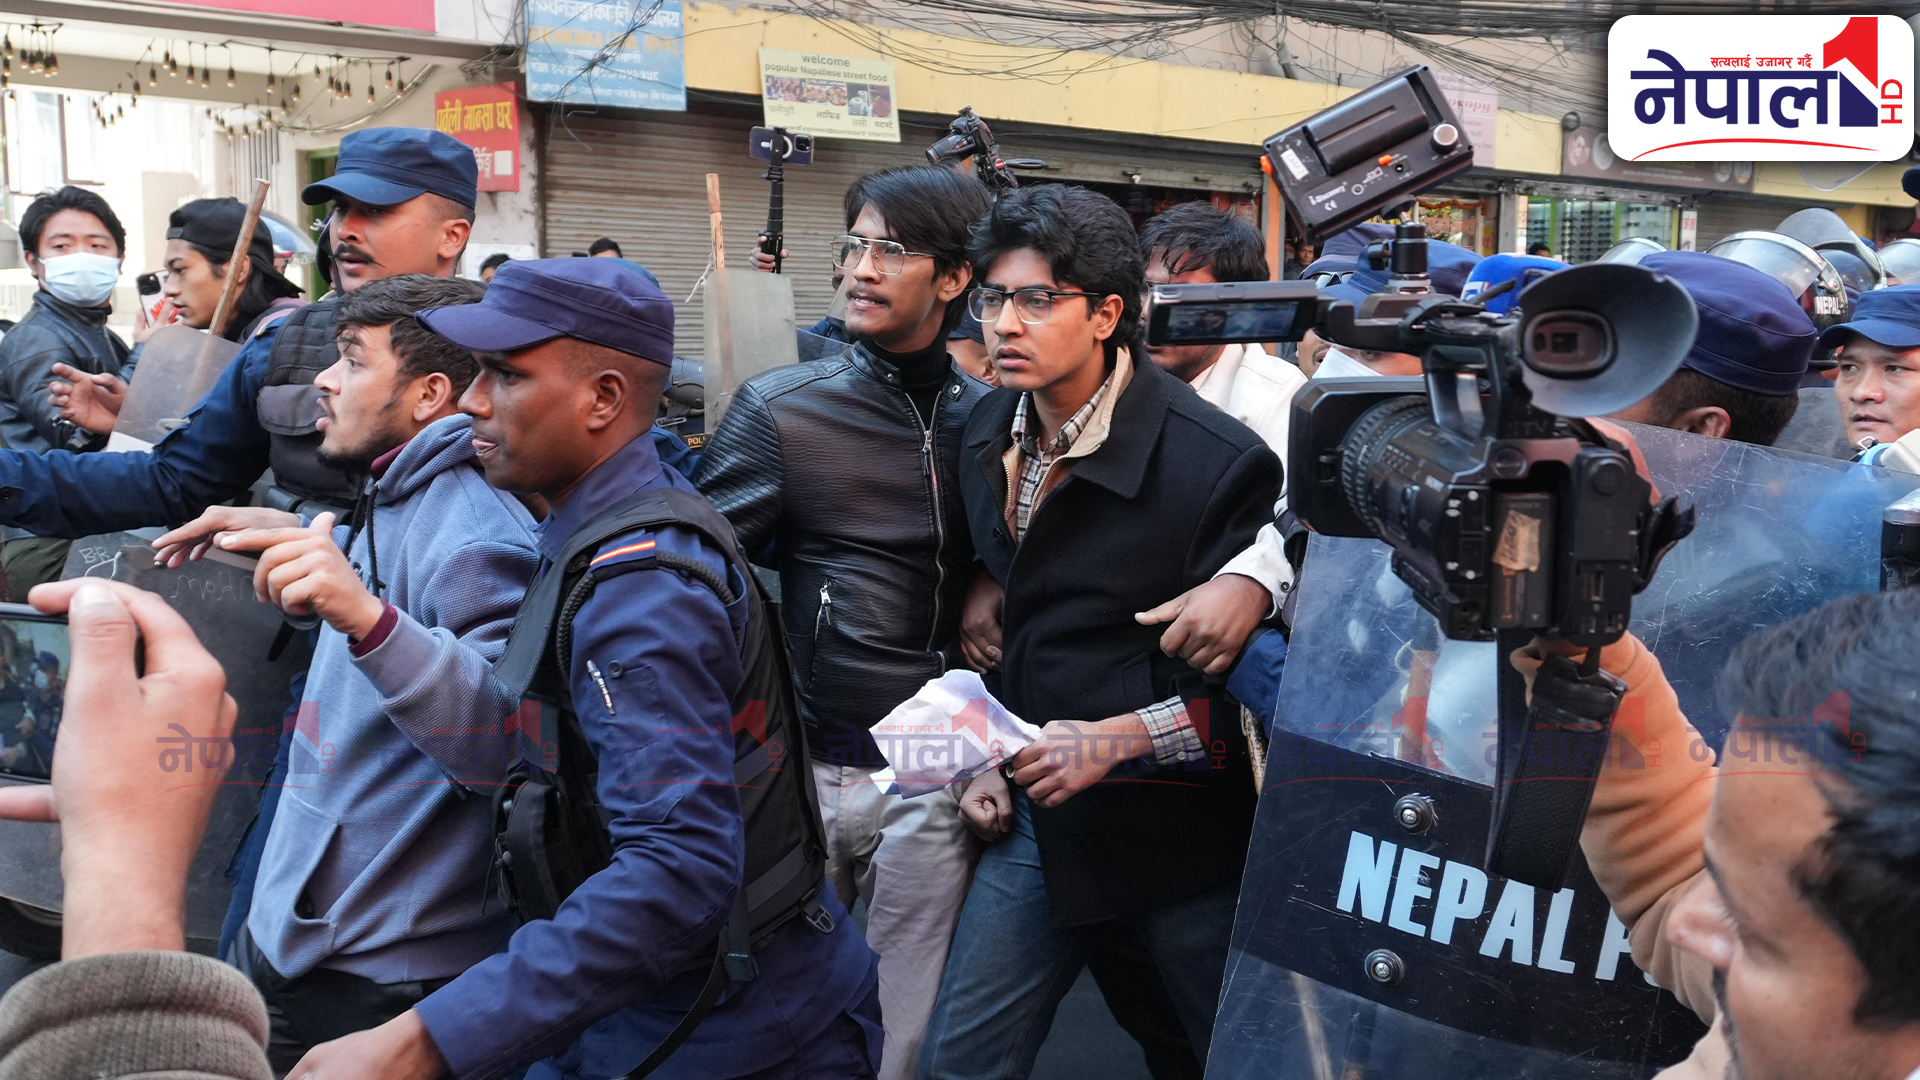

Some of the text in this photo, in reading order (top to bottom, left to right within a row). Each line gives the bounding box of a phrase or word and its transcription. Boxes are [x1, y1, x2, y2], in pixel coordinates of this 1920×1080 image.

[802, 54, 850, 67] welcome
[764, 63, 887, 82] popular Napaliese street food
[496, 101, 513, 130] घर
[1815, 295, 1841, 315] NEPAL
[1336, 830, 1575, 974] NEPAL
